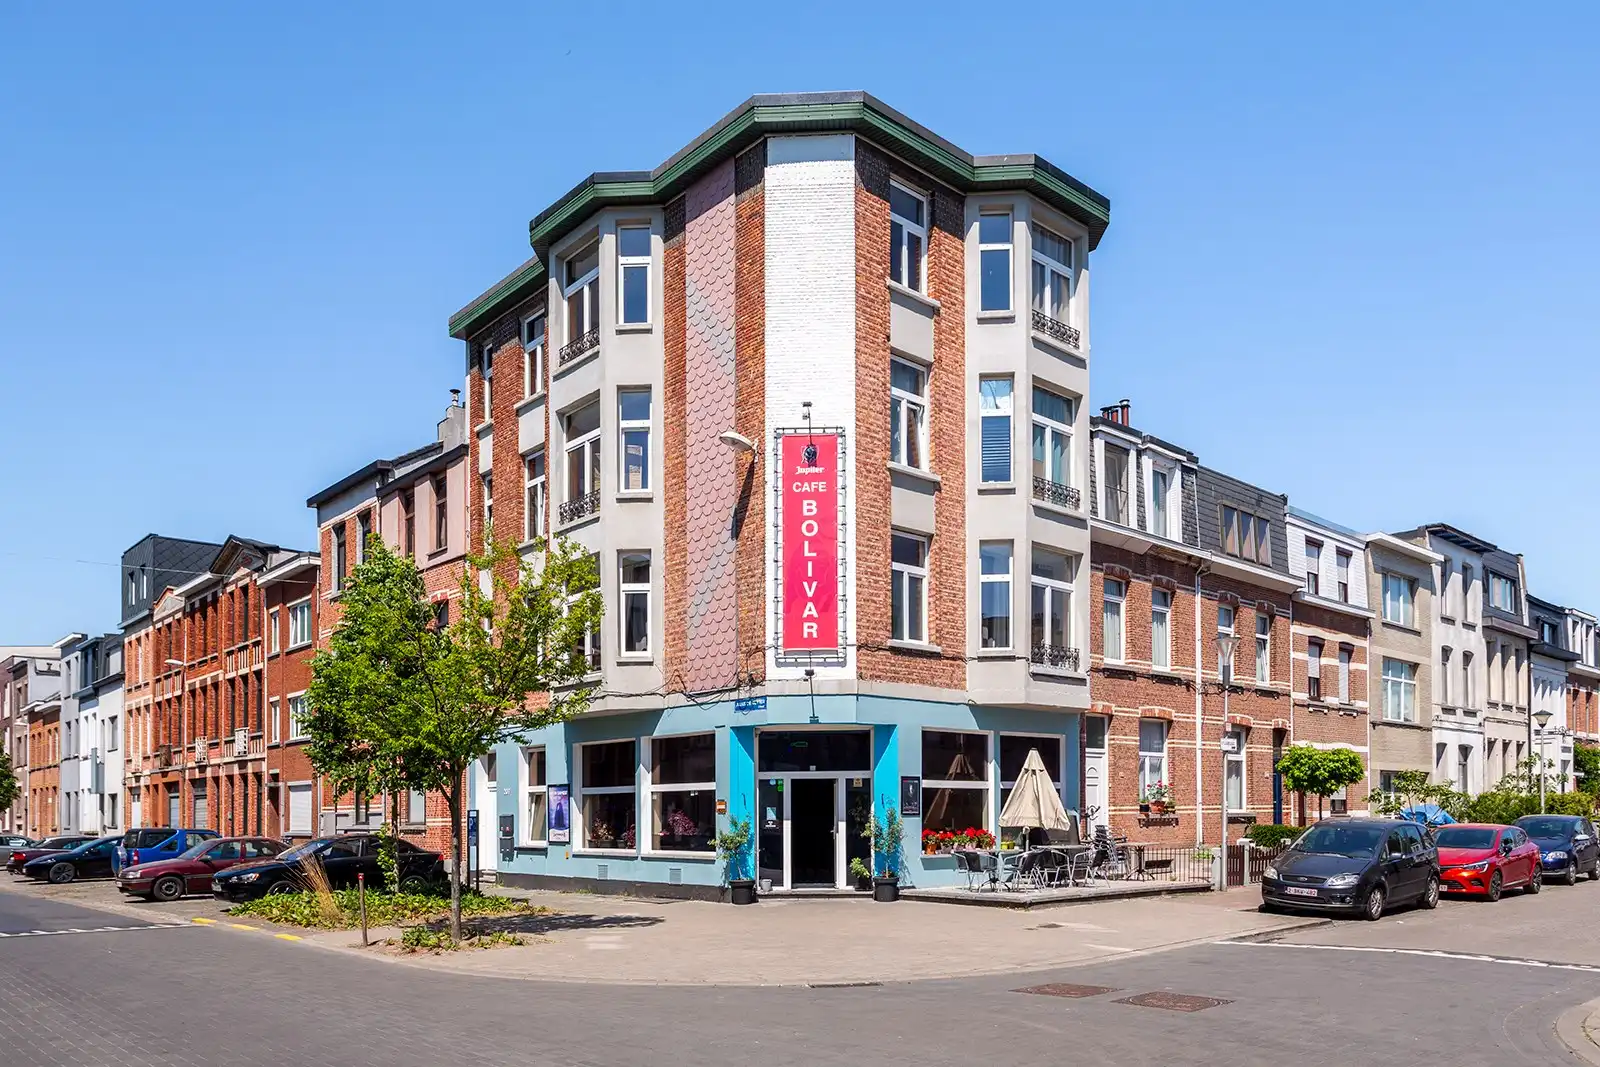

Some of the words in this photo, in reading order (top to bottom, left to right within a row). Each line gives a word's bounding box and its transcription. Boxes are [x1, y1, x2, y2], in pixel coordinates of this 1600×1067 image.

[795, 466, 825, 475] Jupiler
[792, 481, 827, 493] CAFE
[801, 499, 819, 639] BOLIVAR
